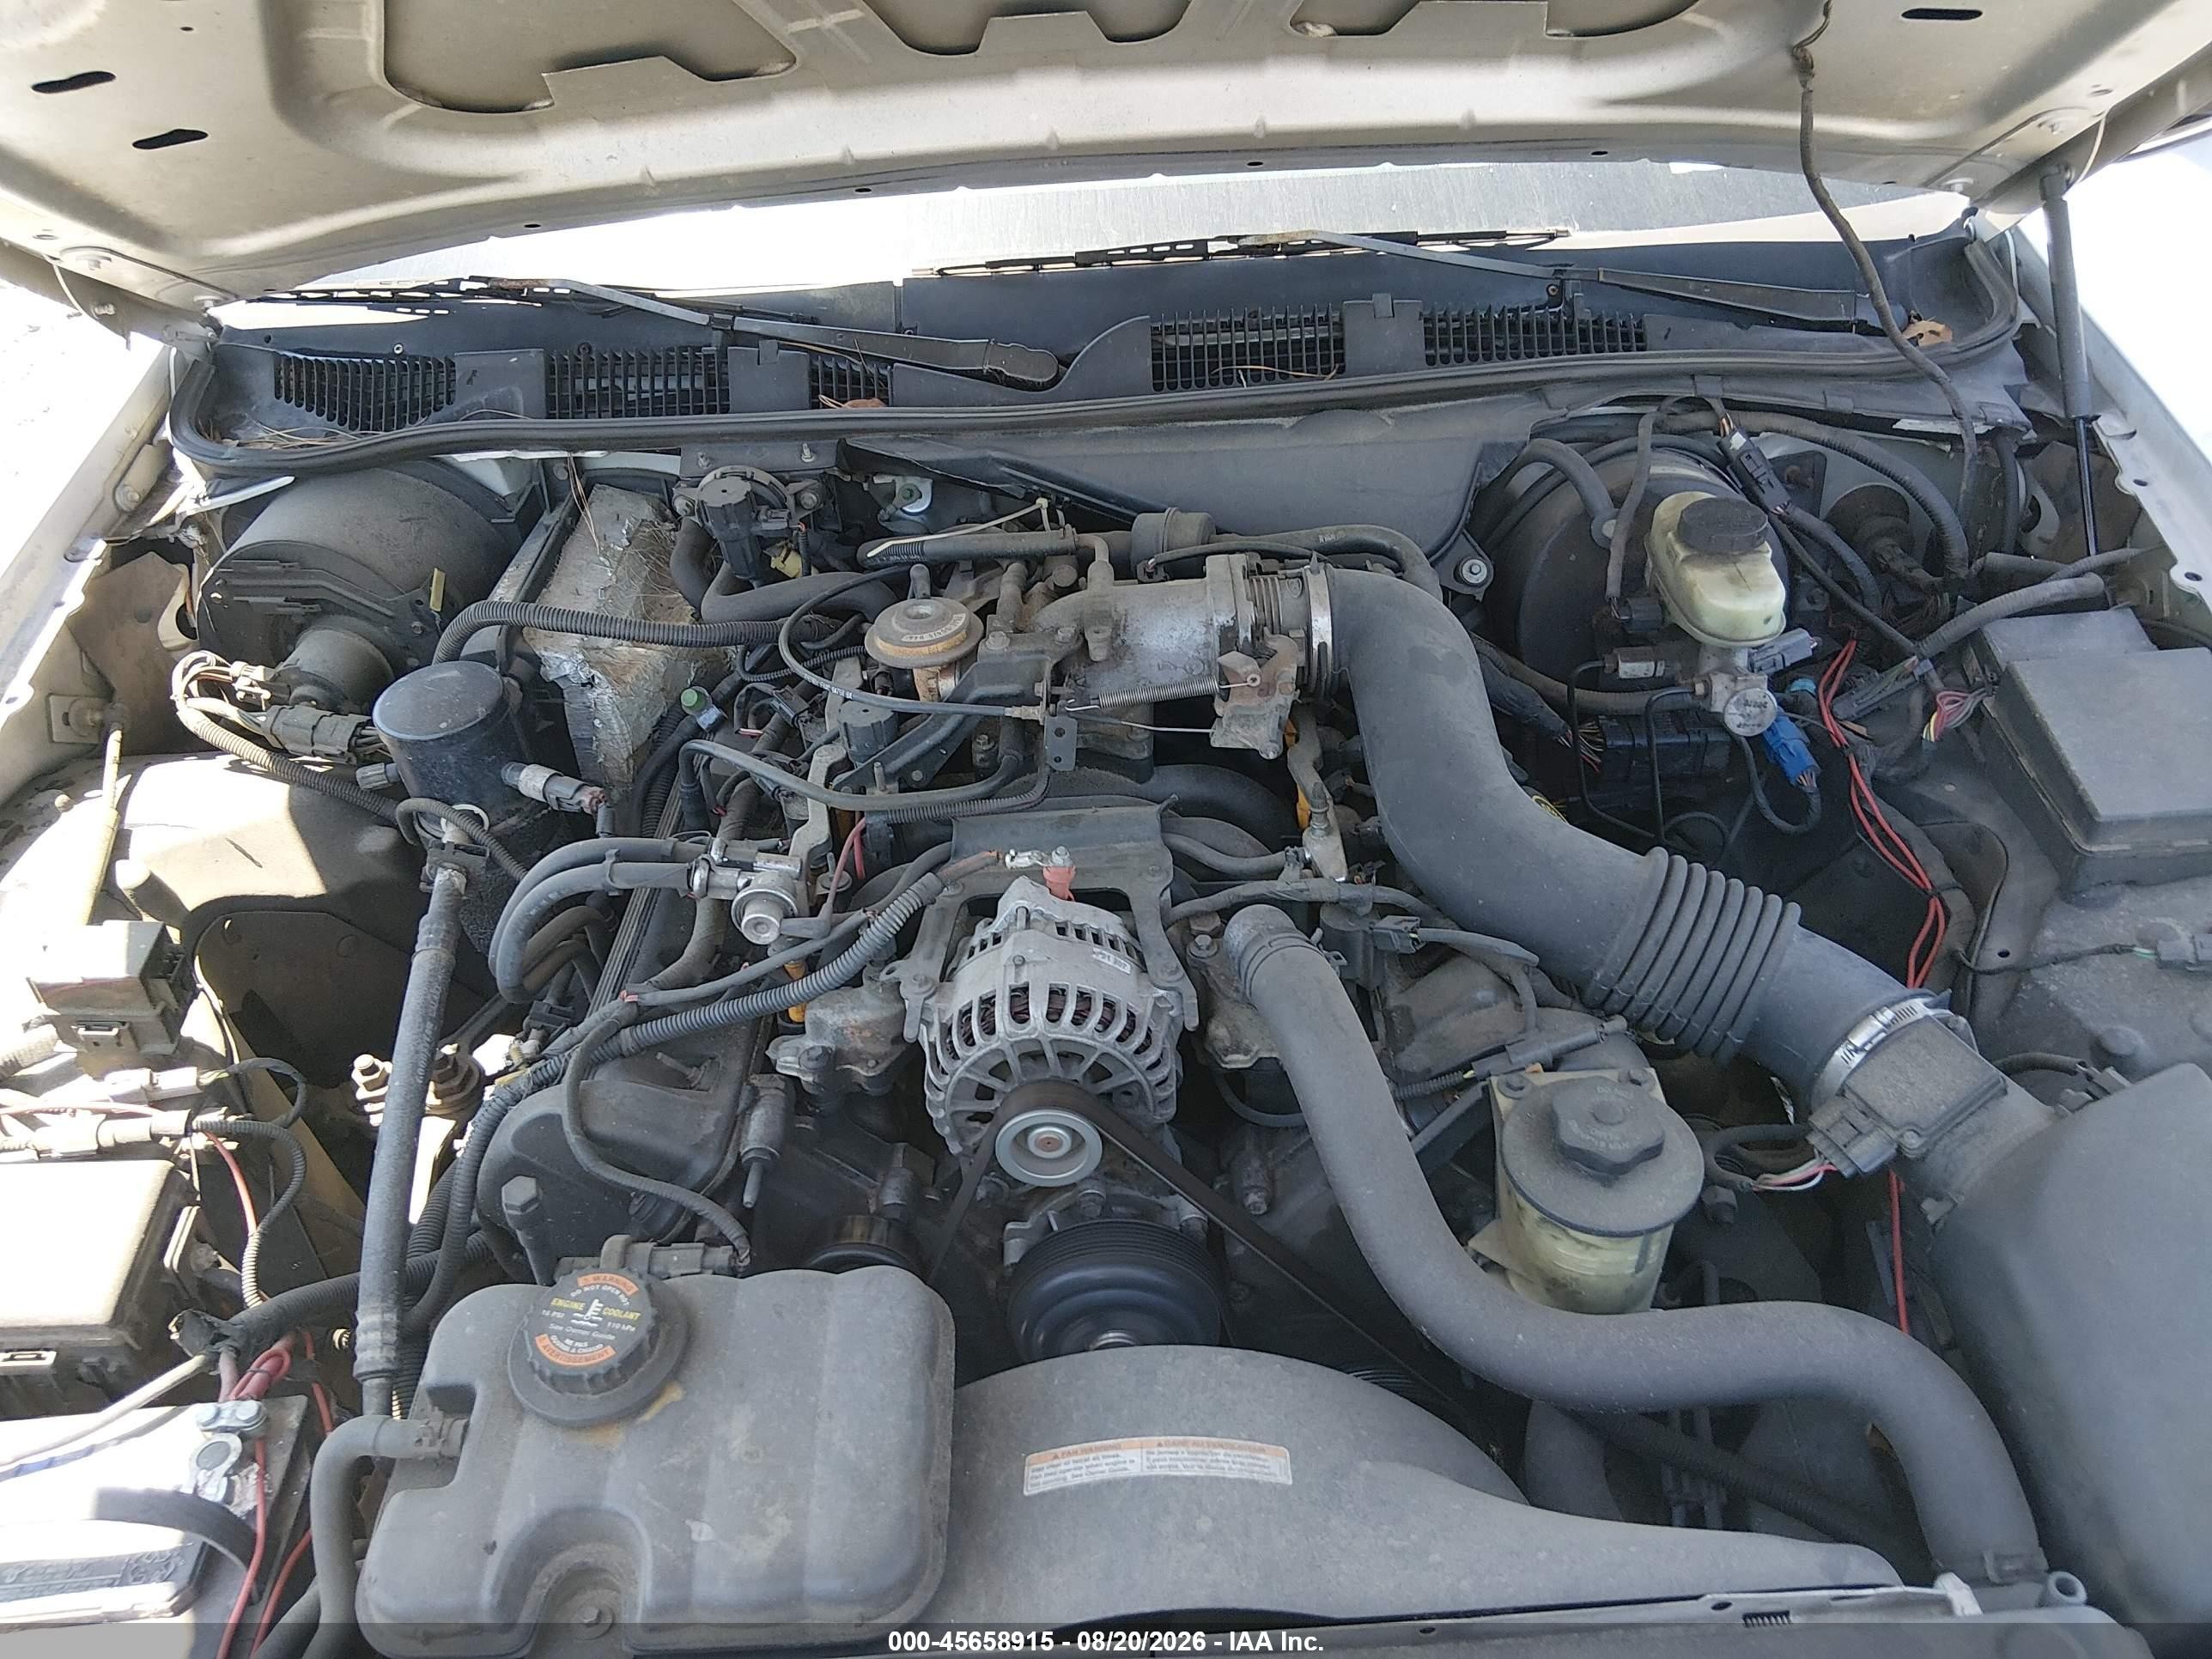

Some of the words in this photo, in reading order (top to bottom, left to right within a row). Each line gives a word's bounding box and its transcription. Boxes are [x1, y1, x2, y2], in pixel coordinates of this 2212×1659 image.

[592, 1274, 634, 1292] WARNING
[570, 1289, 582, 1297] DO
[601, 1285, 621, 1296] OPEN
[618, 1292, 630, 1306] HOT
[550, 1297, 586, 1311] ENGINE
[603, 1307, 641, 1321] COOLANT
[592, 1331, 617, 1340] Guide
